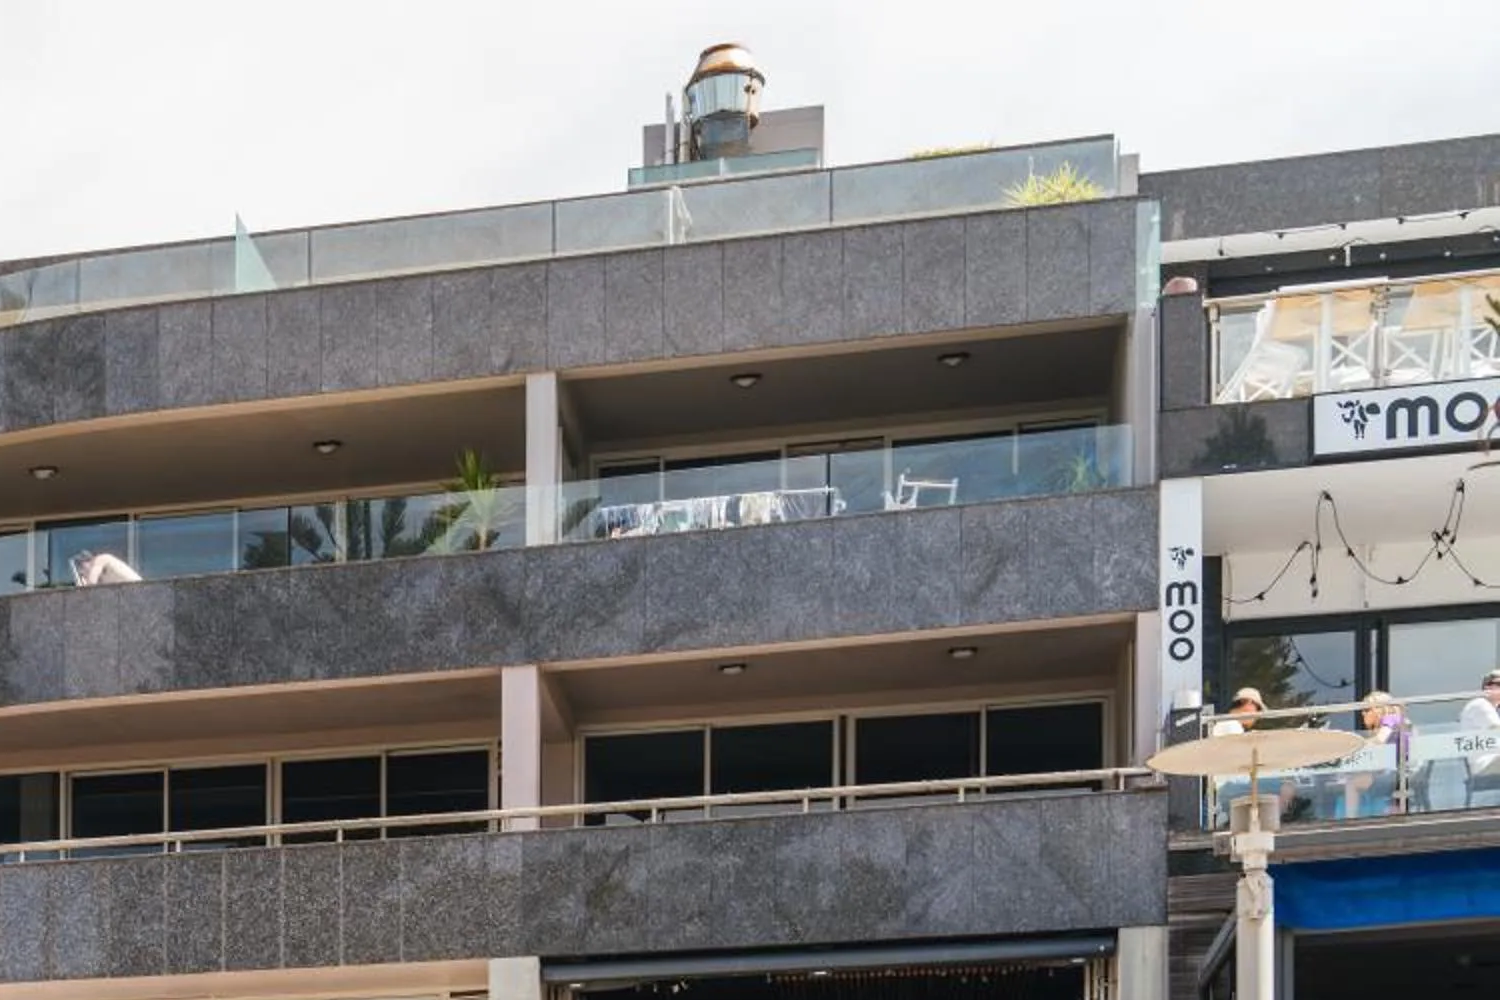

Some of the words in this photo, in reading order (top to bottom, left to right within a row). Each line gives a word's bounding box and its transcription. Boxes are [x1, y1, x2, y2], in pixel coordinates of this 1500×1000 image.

[1386, 391, 1500, 440] mo
[1165, 581, 1198, 661] moo
[1454, 735, 1497, 752] Take
